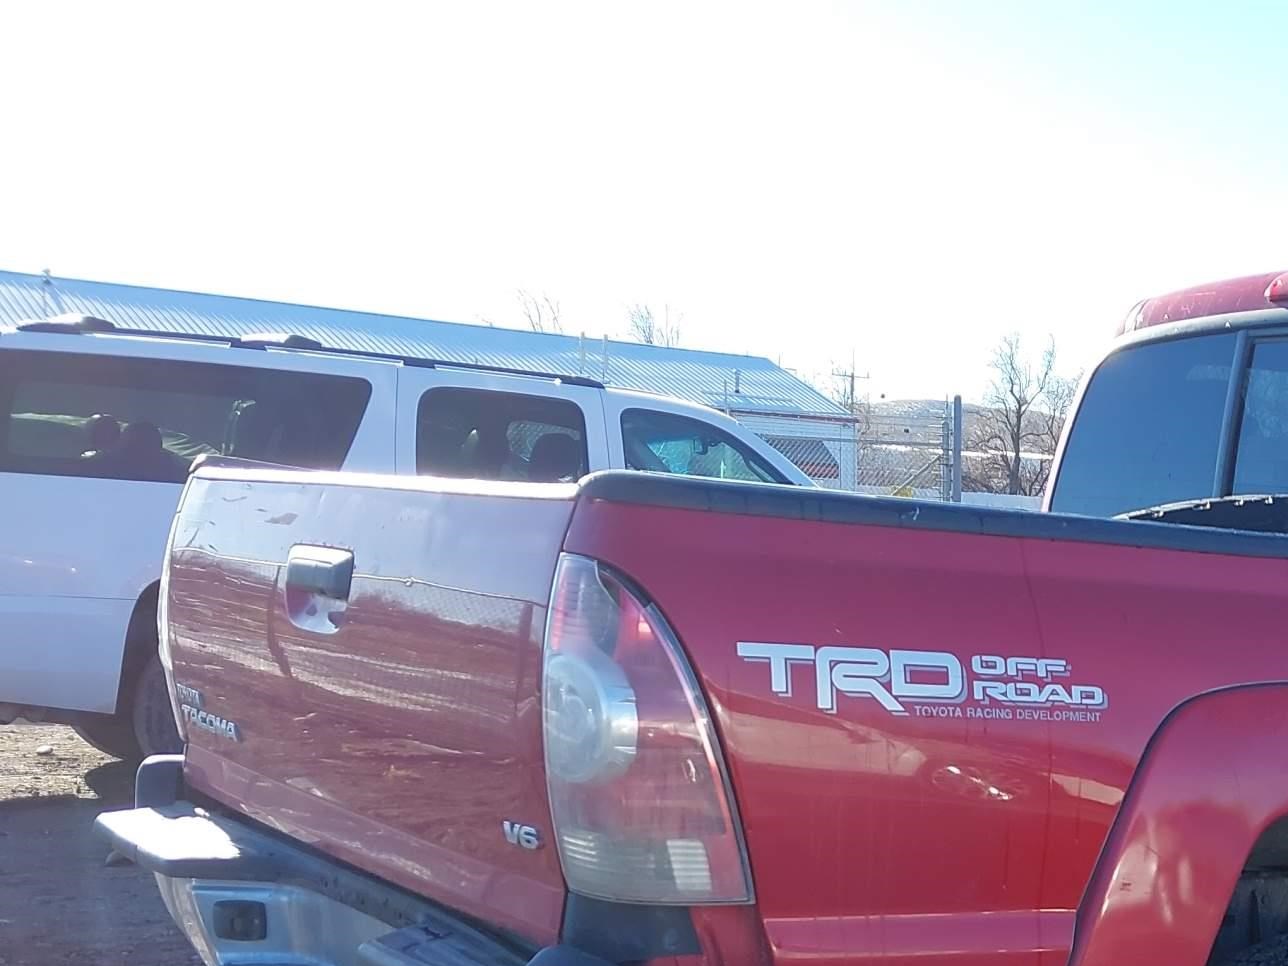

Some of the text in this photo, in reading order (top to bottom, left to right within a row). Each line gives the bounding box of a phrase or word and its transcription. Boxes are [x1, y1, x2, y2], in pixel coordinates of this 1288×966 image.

[736, 641, 967, 716] TRD
[971, 655, 1071, 681] OFF
[972, 680, 1108, 709] ROAD
[181, 703, 238, 742] TACOMA
[914, 705, 1102, 722] TOYOTA RACING DEVELOPMENT
[503, 820, 538, 849] V6
